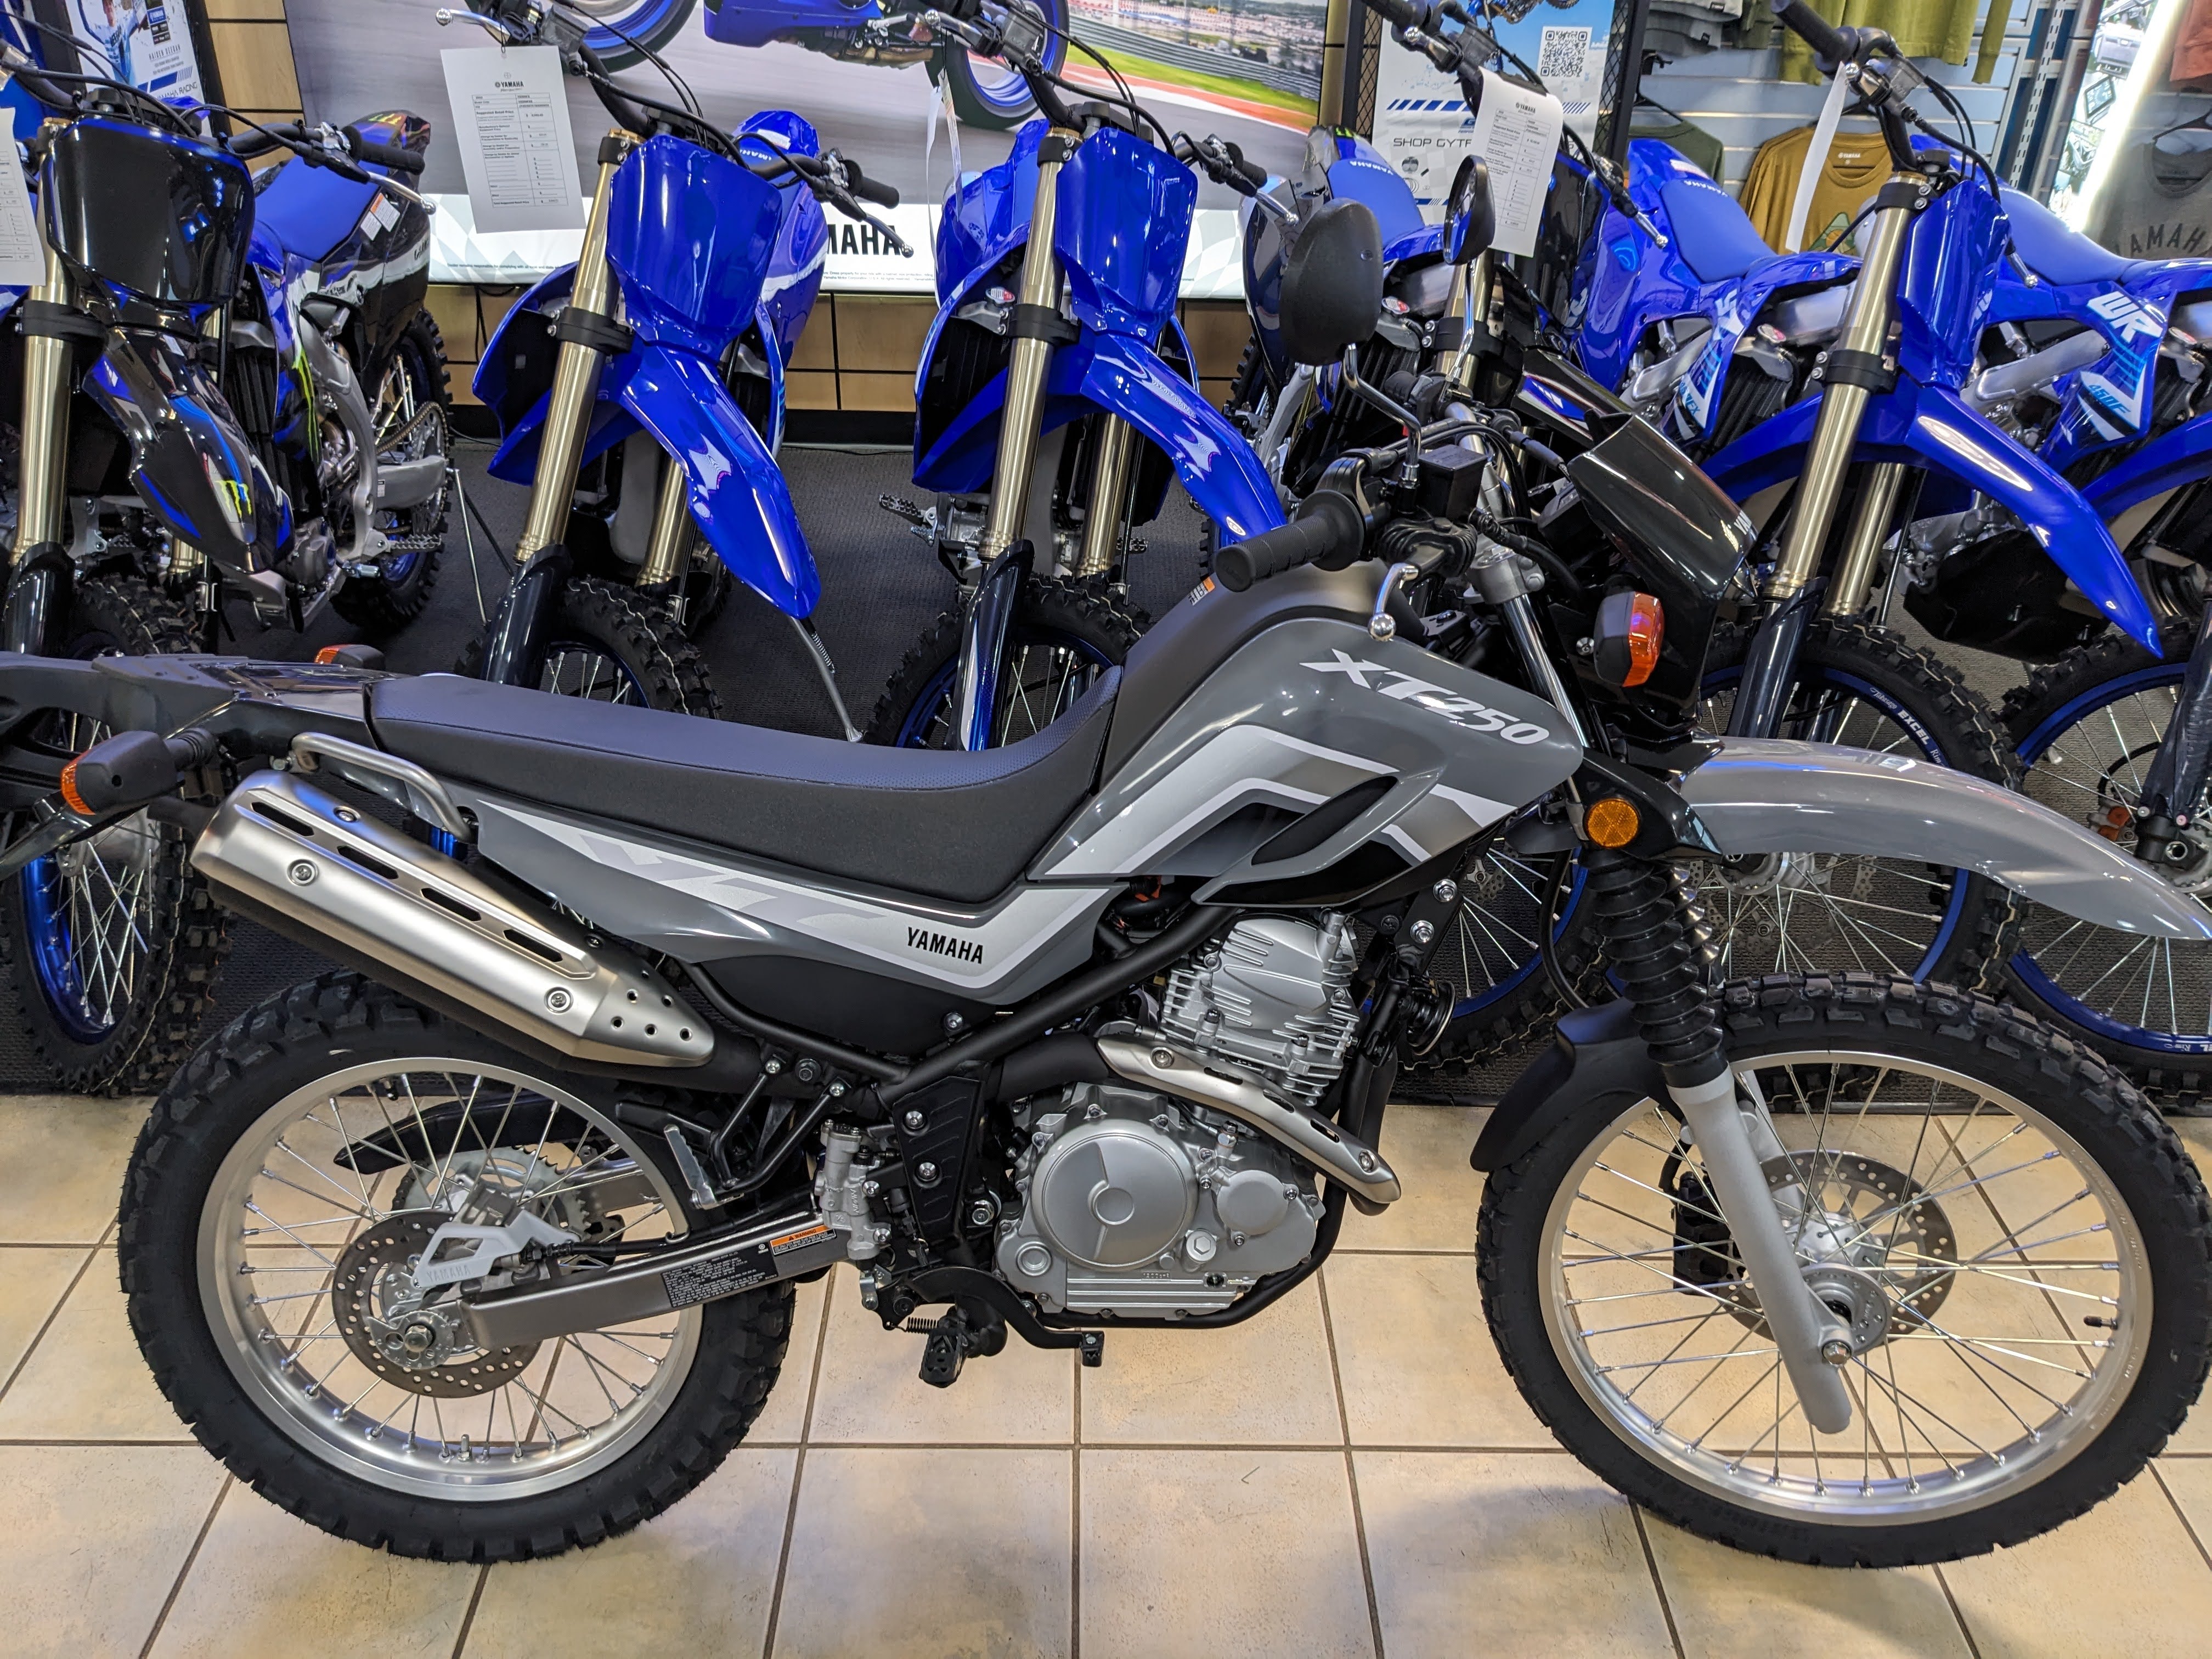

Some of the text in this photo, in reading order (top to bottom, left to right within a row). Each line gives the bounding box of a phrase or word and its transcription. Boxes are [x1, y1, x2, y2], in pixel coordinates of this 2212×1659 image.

[179, 82, 198, 95] RACING
[1520, 103, 1536, 114] YAMAHA
[1393, 138, 1431, 148] SHOP
[1349, 160, 1393, 176] YAMAHA
[1683, 180, 1729, 198] YAMAHA
[827, 224, 901, 255] MAHA
[2087, 291, 2163, 343] WR
[1300, 648, 1550, 745] XT250
[1869, 687, 1898, 709] Takasago
[1898, 709, 1930, 745] EXCEL
[907, 927, 984, 964] YAMAHA
[795, 1229, 817, 1239] WARNING
[426, 1265, 470, 1282] YAMAHA
